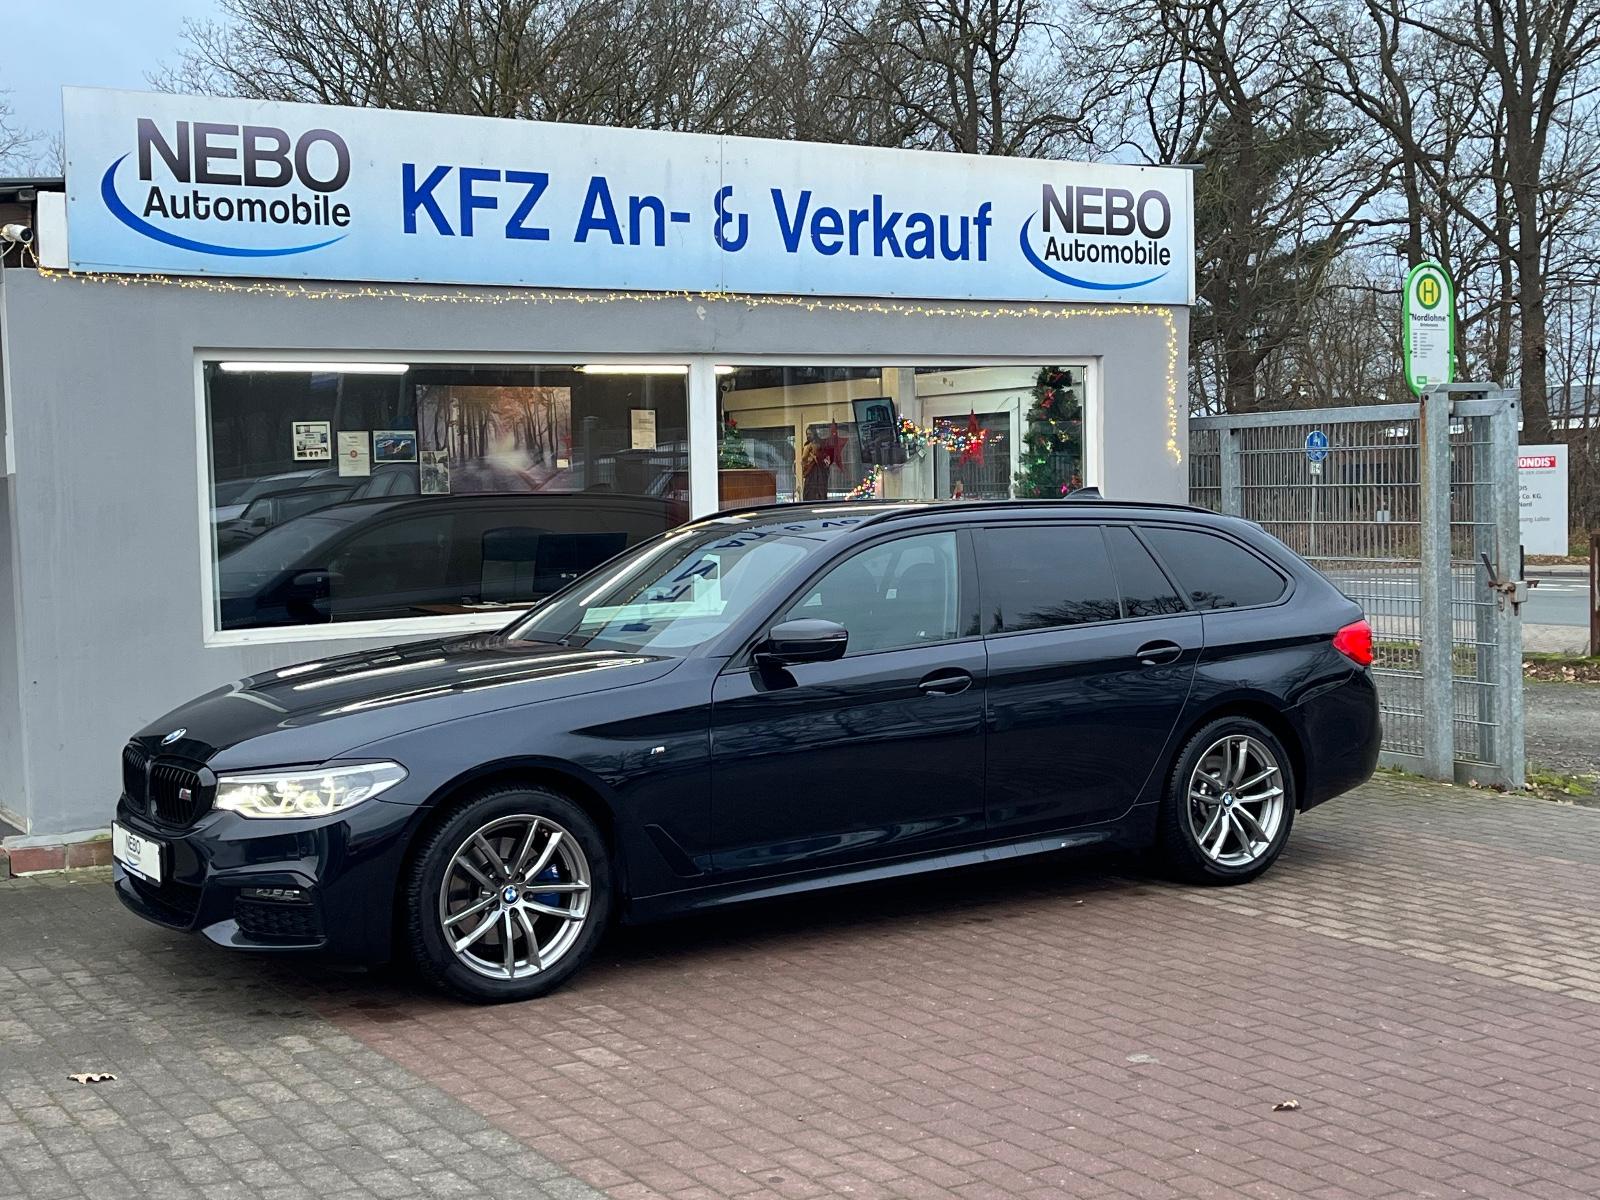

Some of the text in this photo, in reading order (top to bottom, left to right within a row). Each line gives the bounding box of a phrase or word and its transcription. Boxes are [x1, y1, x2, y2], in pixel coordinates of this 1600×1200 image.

[138, 119, 350, 192] NEBO
[143, 186, 351, 227] Automobile
[402, 163, 993, 262] KFZ An- & Verkauf
[1042, 183, 1171, 240] NEBO
[1044, 237, 1171, 266] Automobile
[1411, 313, 1446, 322] Nordlohne
[1518, 457, 1551, 468] ONDIS
